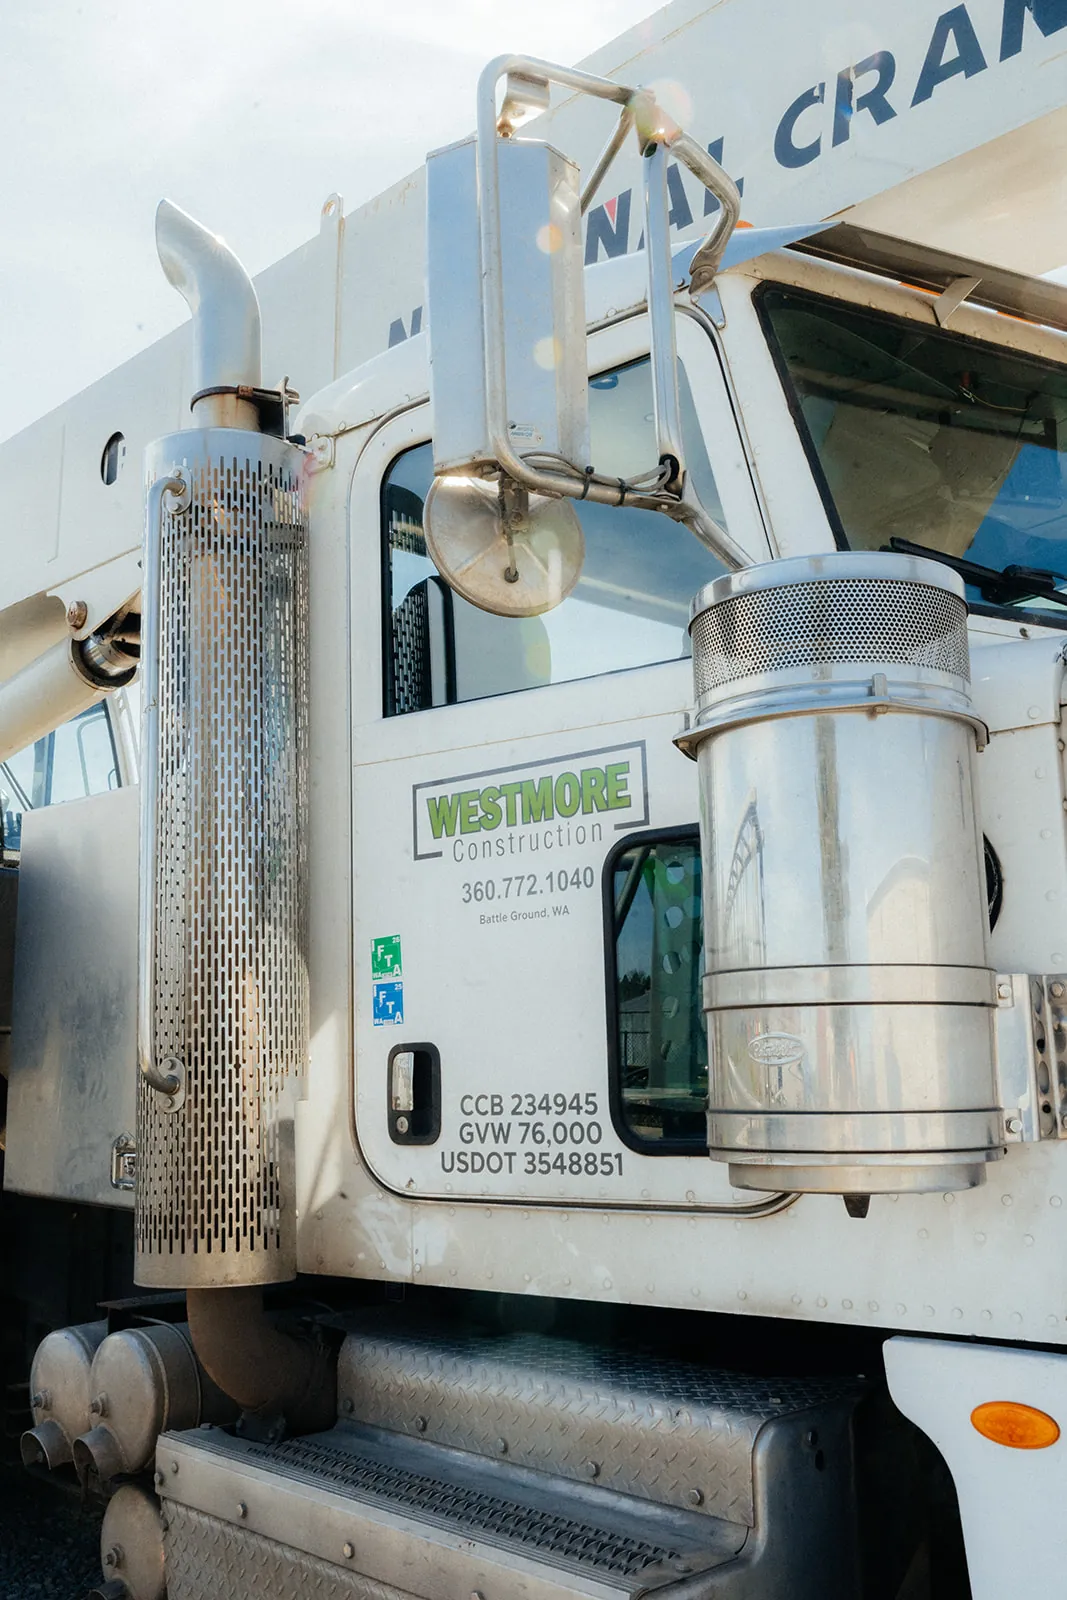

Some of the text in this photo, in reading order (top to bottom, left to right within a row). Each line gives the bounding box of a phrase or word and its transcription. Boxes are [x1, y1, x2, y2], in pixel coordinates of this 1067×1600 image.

[426, 761, 632, 840] WESTMORE
[453, 821, 603, 863] Construction
[461, 866, 595, 904] 360.772.1040
[479, 913, 508, 925] Battle
[552, 905, 570, 917] WA
[459, 1092, 599, 1116] CCB 234945
[458, 1120, 603, 1148] GVW 76,000
[440, 1150, 623, 1176] USDOT 3548851
